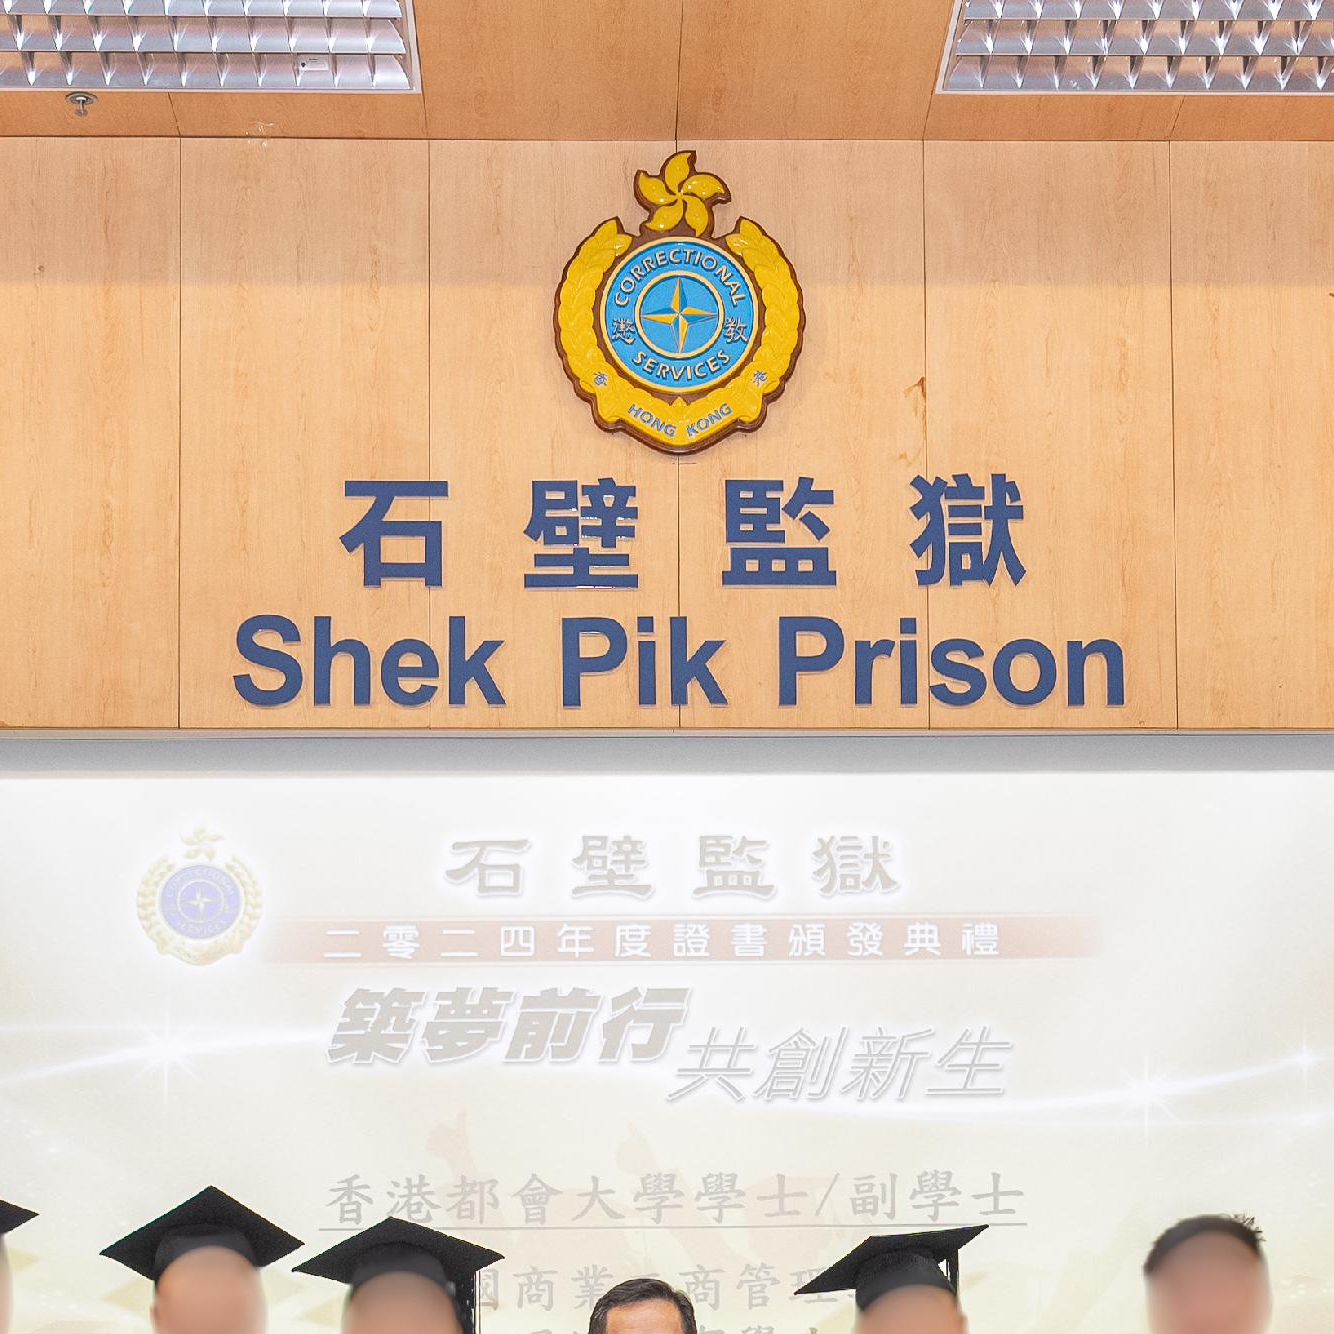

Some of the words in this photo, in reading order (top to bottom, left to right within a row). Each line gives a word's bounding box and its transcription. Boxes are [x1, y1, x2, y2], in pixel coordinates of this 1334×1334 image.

[613, 248, 748, 307] CORRECTIONAL
[723, 316, 749, 344] 教
[632, 350, 732, 382] SERVICES
[627, 404, 677, 438] HONG
[686, 403, 732, 438] KONG
[338, 473, 1026, 589] 石壁監獄
[233, 615, 505, 709] Shek
[563, 616, 727, 708] Pik
[779, 616, 1125, 709] Prison
[443, 832, 904, 901] 石壁監獄
[323, 922, 1000, 959] 二零二四年度證書頒發典禮
[327, 985, 688, 1067] 築夢前行
[667, 1024, 1013, 1104] 共創新生
[324, 1170, 1025, 1225] 香港都會大學學士/副學士
